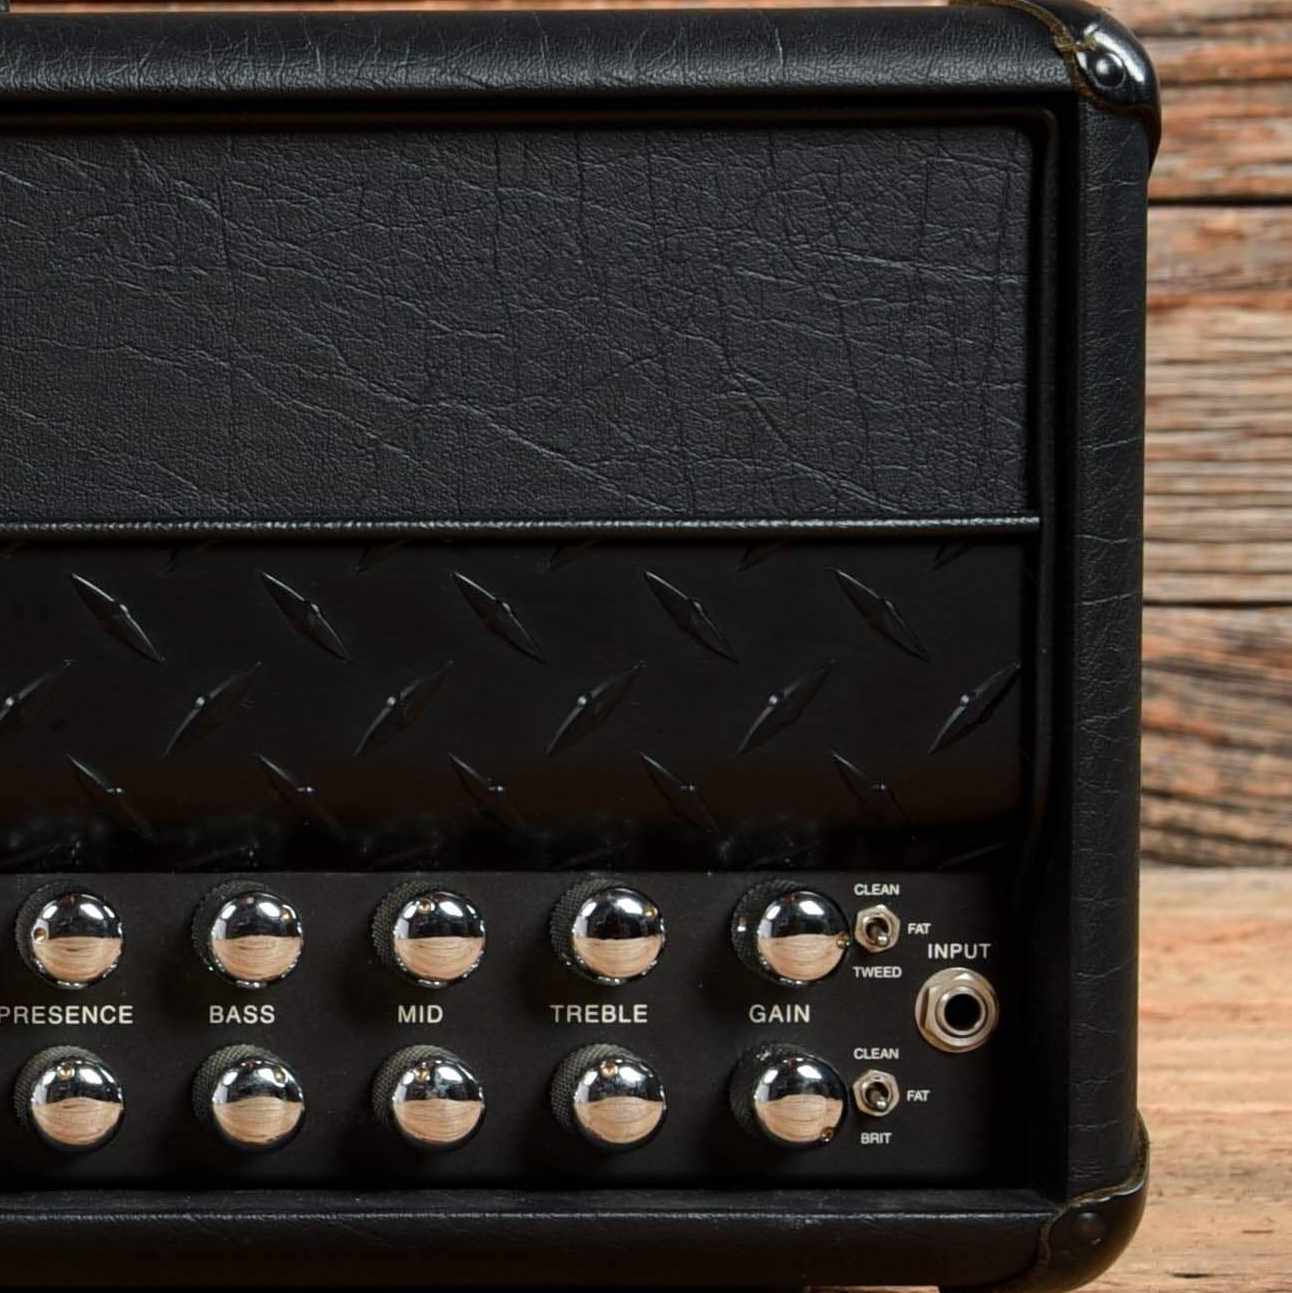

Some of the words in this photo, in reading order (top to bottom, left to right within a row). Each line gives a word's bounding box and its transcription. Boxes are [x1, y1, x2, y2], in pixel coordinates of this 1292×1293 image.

[853, 883, 901, 896] CLEAN
[907, 923, 932, 935] FAT
[927, 942, 992, 960] INPUT
[853, 965, 903, 979] TWEED
[209, 1004, 276, 1025] BASS
[398, 1004, 444, 1024] MID
[549, 1003, 649, 1024] TREBLE
[749, 1003, 811, 1024] GAIN
[853, 1047, 900, 1061] CLEAN
[906, 1090, 931, 1102] FAT
[860, 1131, 893, 1145] BRIT
